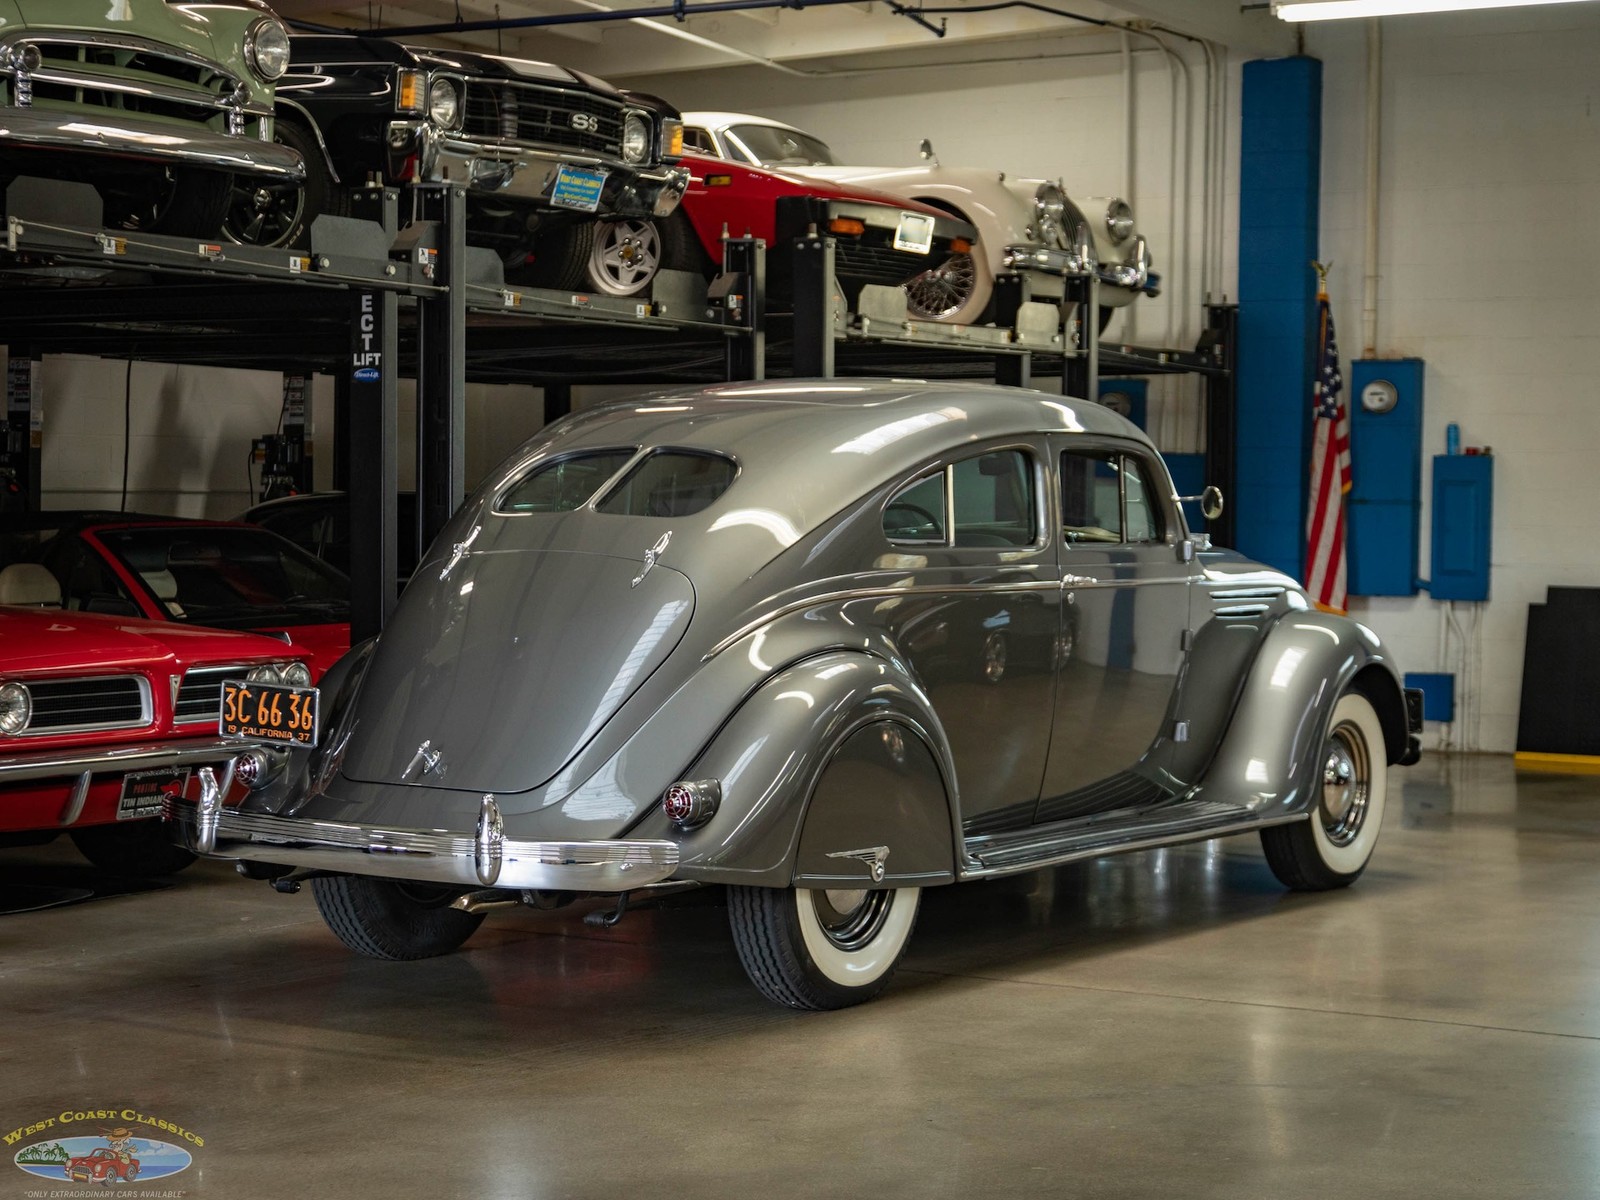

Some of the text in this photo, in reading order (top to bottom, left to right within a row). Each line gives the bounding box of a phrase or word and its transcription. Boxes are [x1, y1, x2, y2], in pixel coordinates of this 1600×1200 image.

[572, 113, 598, 132] SS
[361, 294, 374, 351] ECT
[353, 353, 381, 366] LIFT
[224, 687, 313, 730] 3C 66 36
[227, 724, 311, 741] 19 CALIFORNIA 37
[122, 797, 137, 808] TIN
